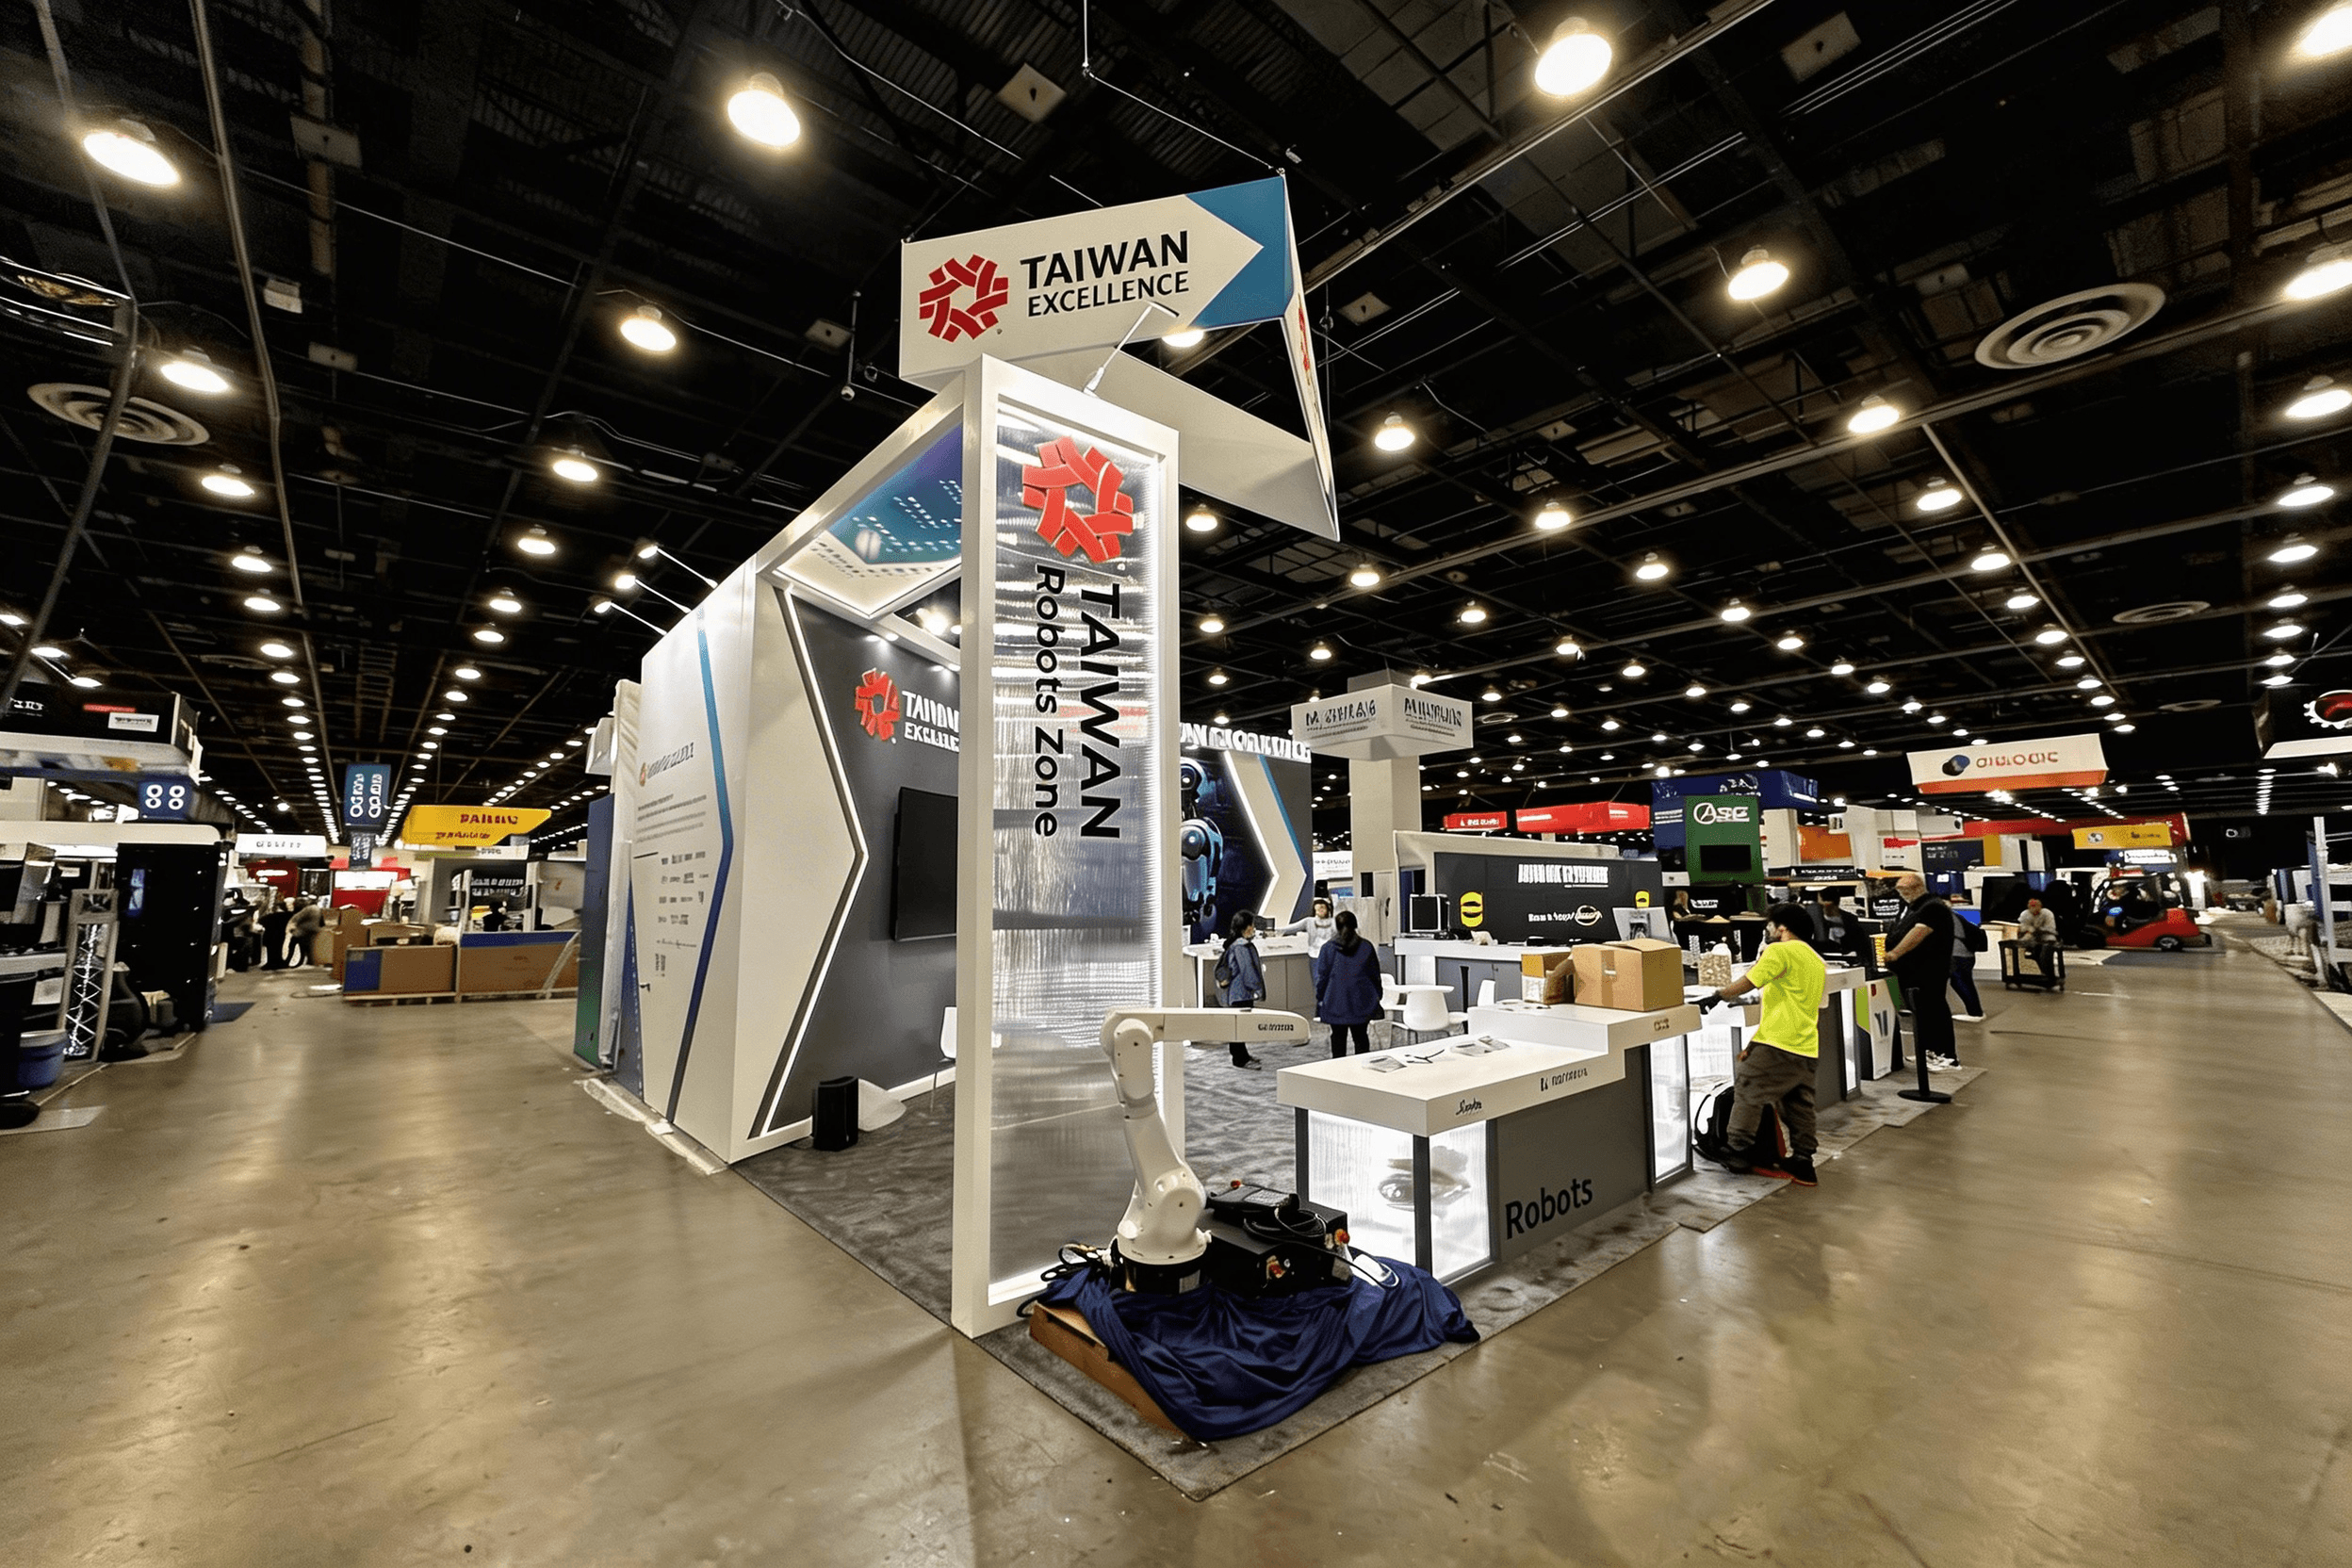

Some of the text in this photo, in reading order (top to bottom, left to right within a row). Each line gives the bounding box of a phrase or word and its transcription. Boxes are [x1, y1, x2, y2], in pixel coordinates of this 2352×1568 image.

[1020, 231, 1188, 289] TAIWAN
[1028, 270, 1189, 317] EXCELLENCE
[1035, 564, 1066, 837] Robots Zone
[1081, 583, 1120, 838] TAIWAN
[1505, 1178, 1593, 1240] Robots
